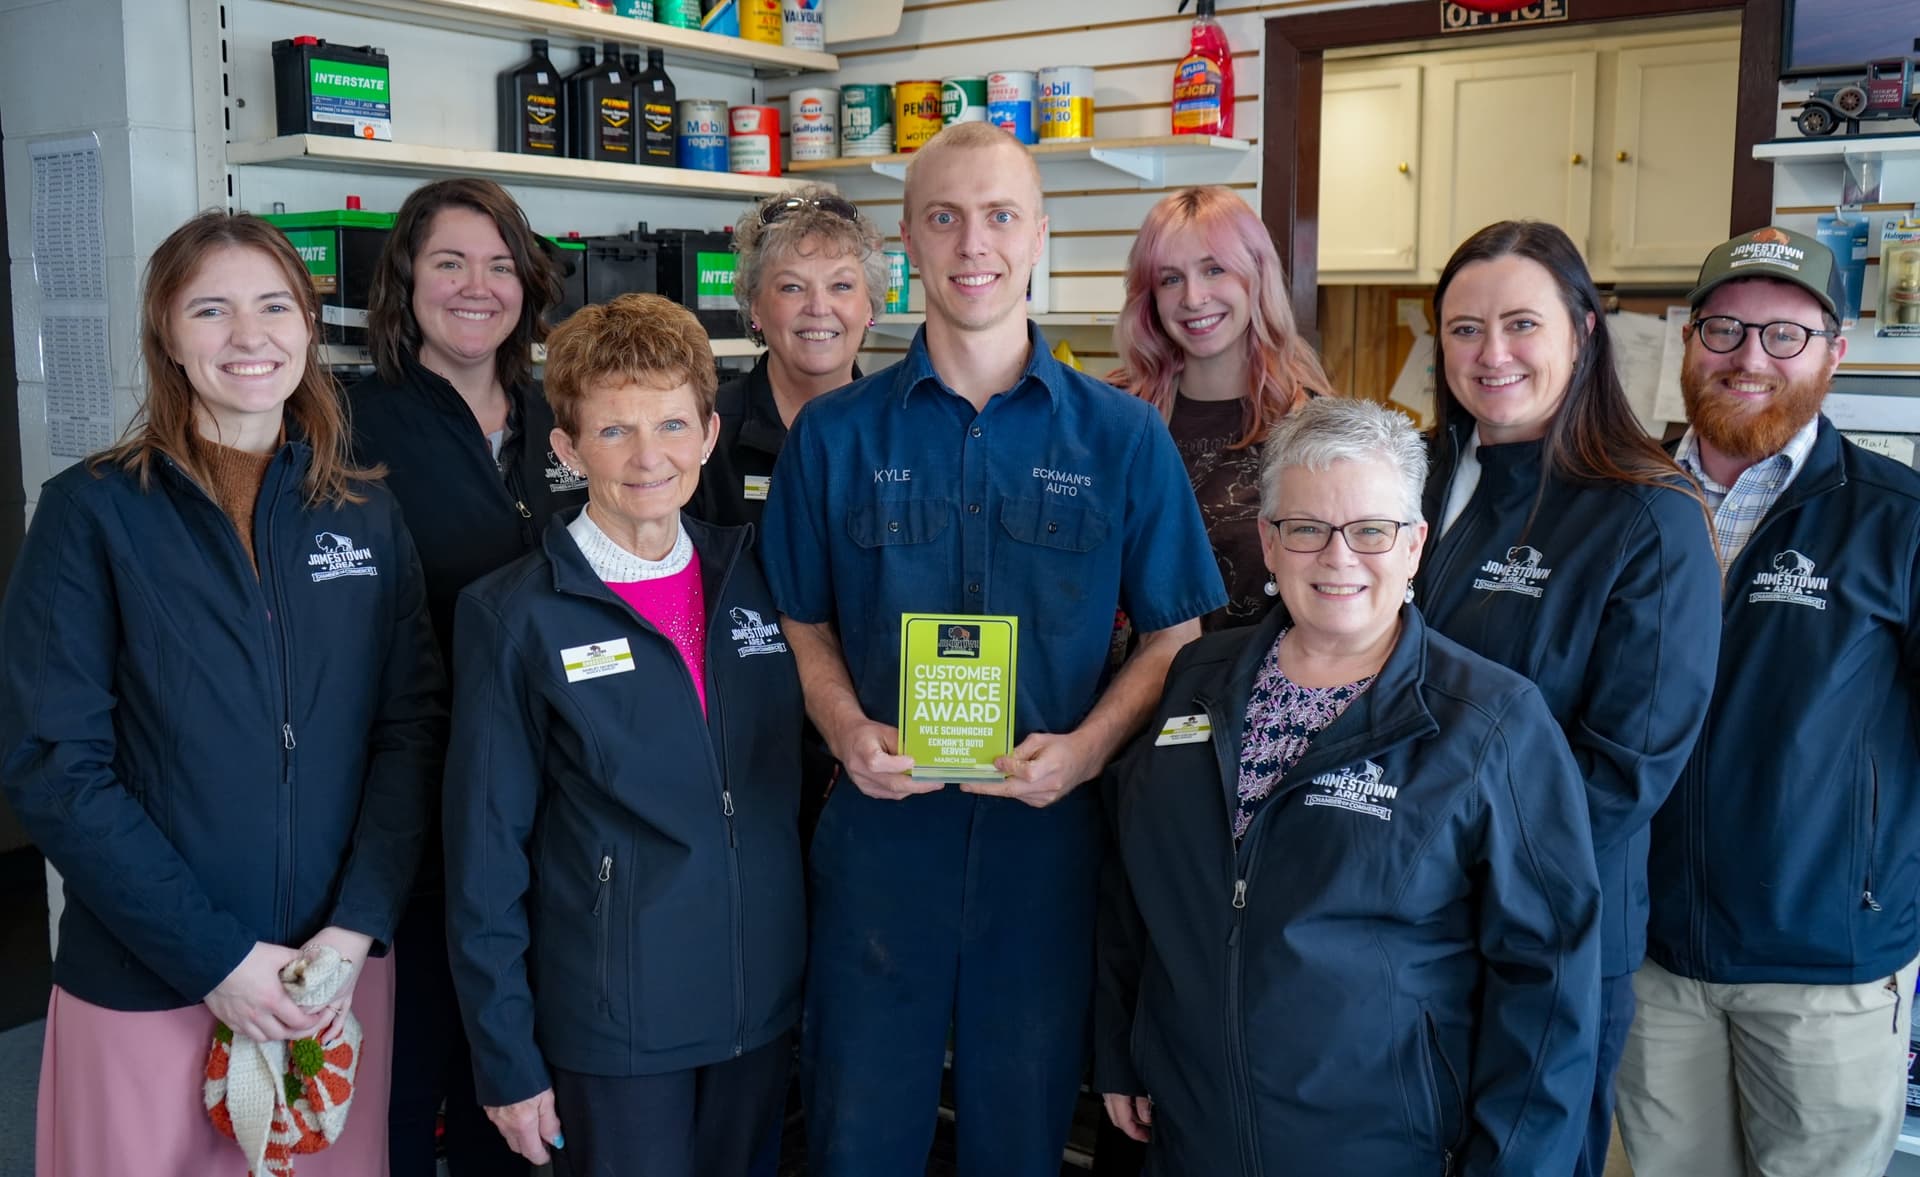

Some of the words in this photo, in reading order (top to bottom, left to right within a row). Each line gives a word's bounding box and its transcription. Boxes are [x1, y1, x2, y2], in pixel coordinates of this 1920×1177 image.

[315, 72, 385, 90] INTERSTATE
[800, 105, 823, 113] Gulf
[792, 123, 833, 133] Gulfpride
[688, 137, 725, 149] regula
[1884, 231, 1913, 241] Halogen
[1730, 243, 1805, 260] JAMESTOWN
[874, 469, 911, 483] KYLE
[1032, 467, 1092, 487] ECKMAN'S
[1046, 482, 1078, 497] AUTO
[308, 547, 372, 566] JAMESTOWN
[329, 561, 355, 571] AREA
[1481, 560, 1552, 580] JAMESTOWN
[1500, 576, 1526, 585] AREA
[1752, 572, 1829, 591] JAMESTOWN
[1772, 585, 1804, 595] AREA
[914, 664, 1002, 681] CUSTOMER
[914, 681, 1001, 701] SERVICE
[913, 702, 1001, 723] AWARD
[920, 725, 939, 735] KYLE
[941, 726, 993, 737] SCHUMACHER
[1312, 773, 1398, 800] JAMESTOWN
[1333, 789, 1368, 803] AREA
